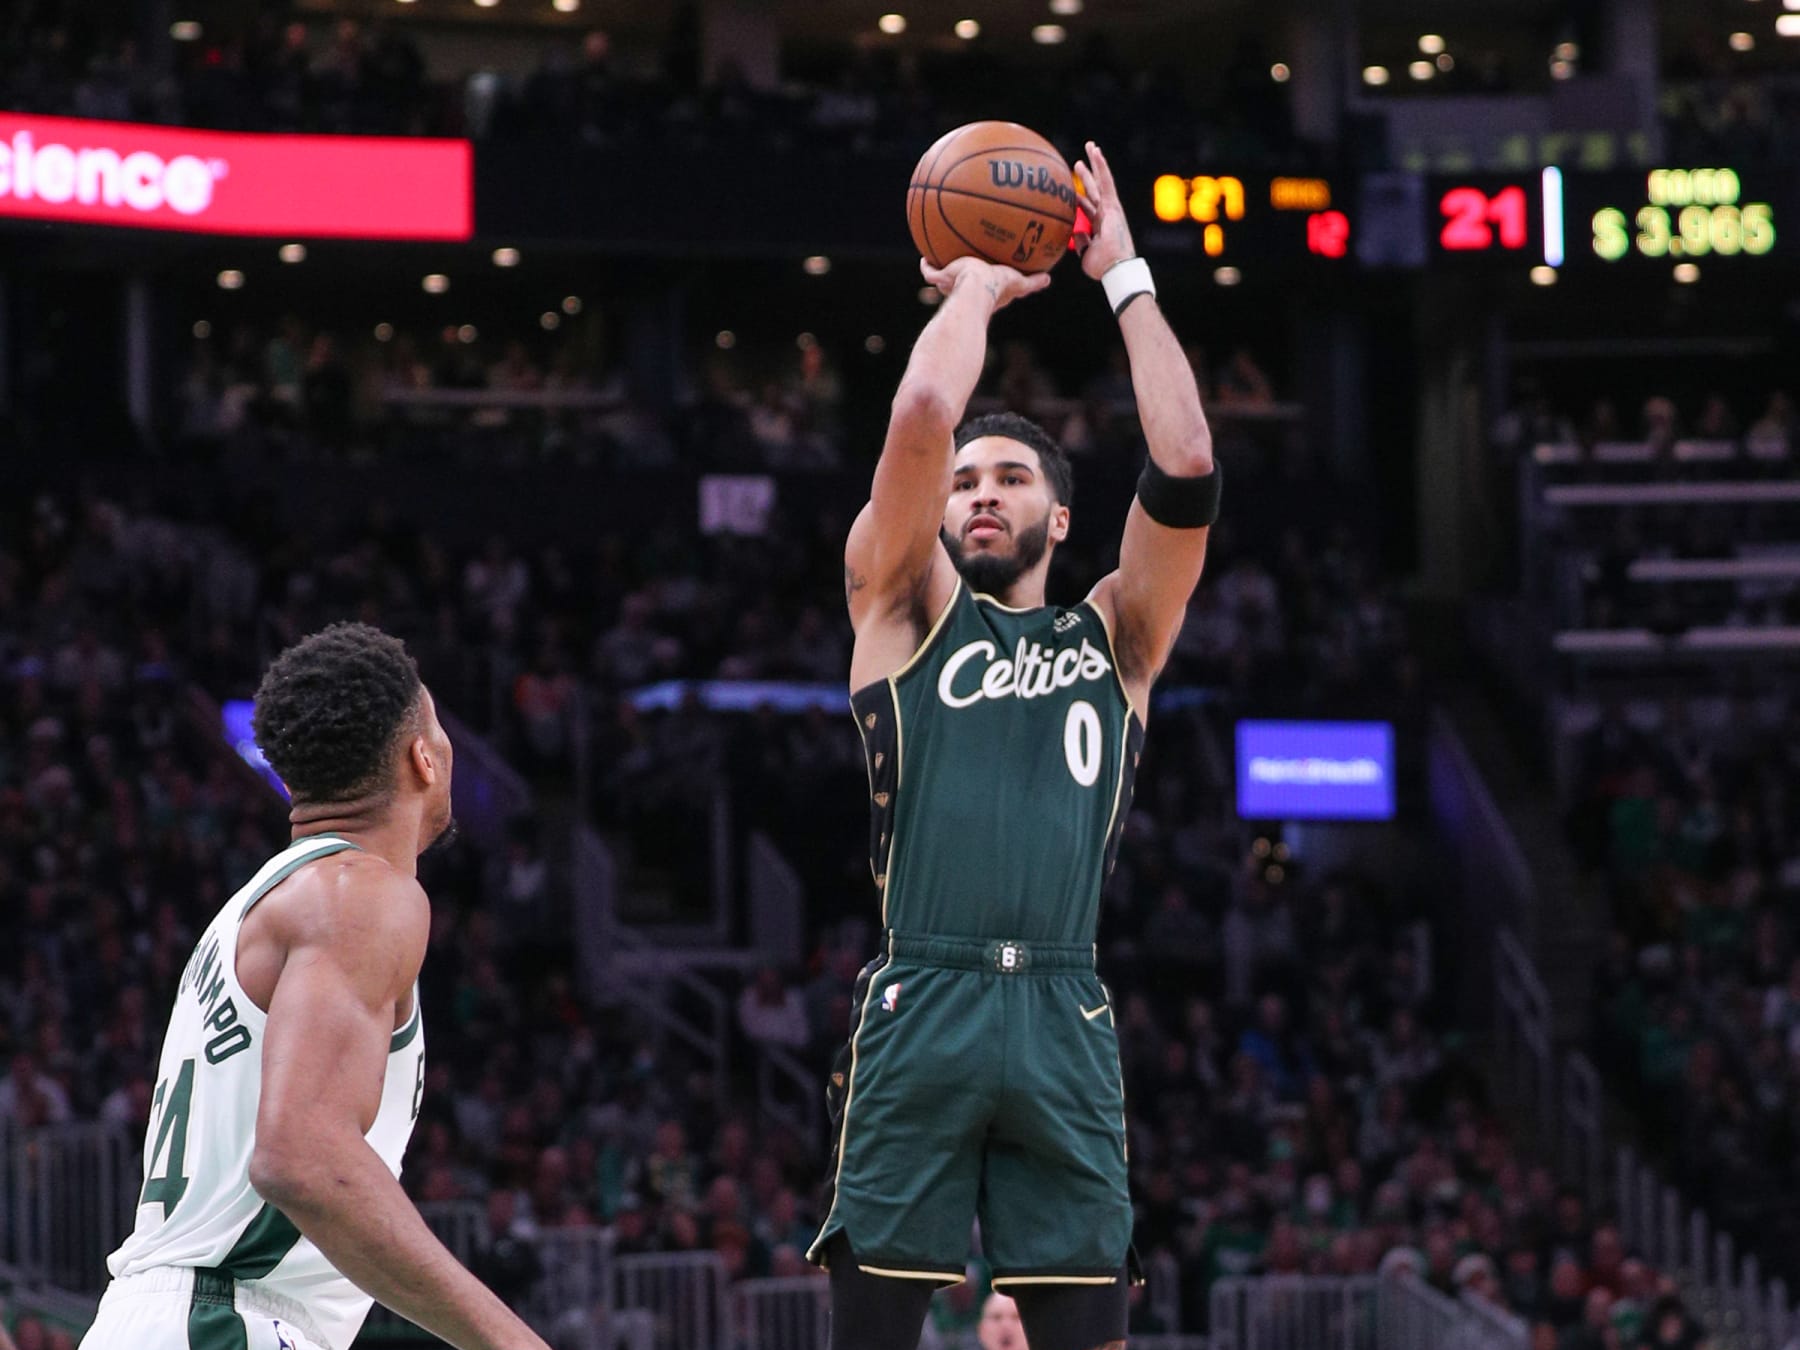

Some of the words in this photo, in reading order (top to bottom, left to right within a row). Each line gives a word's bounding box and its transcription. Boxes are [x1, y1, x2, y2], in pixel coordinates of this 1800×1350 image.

[1440, 186, 1527, 250] 21
[938, 636, 1112, 709] Celtics
[1064, 700, 1102, 787] 0
[1002, 946, 1017, 968] 6
